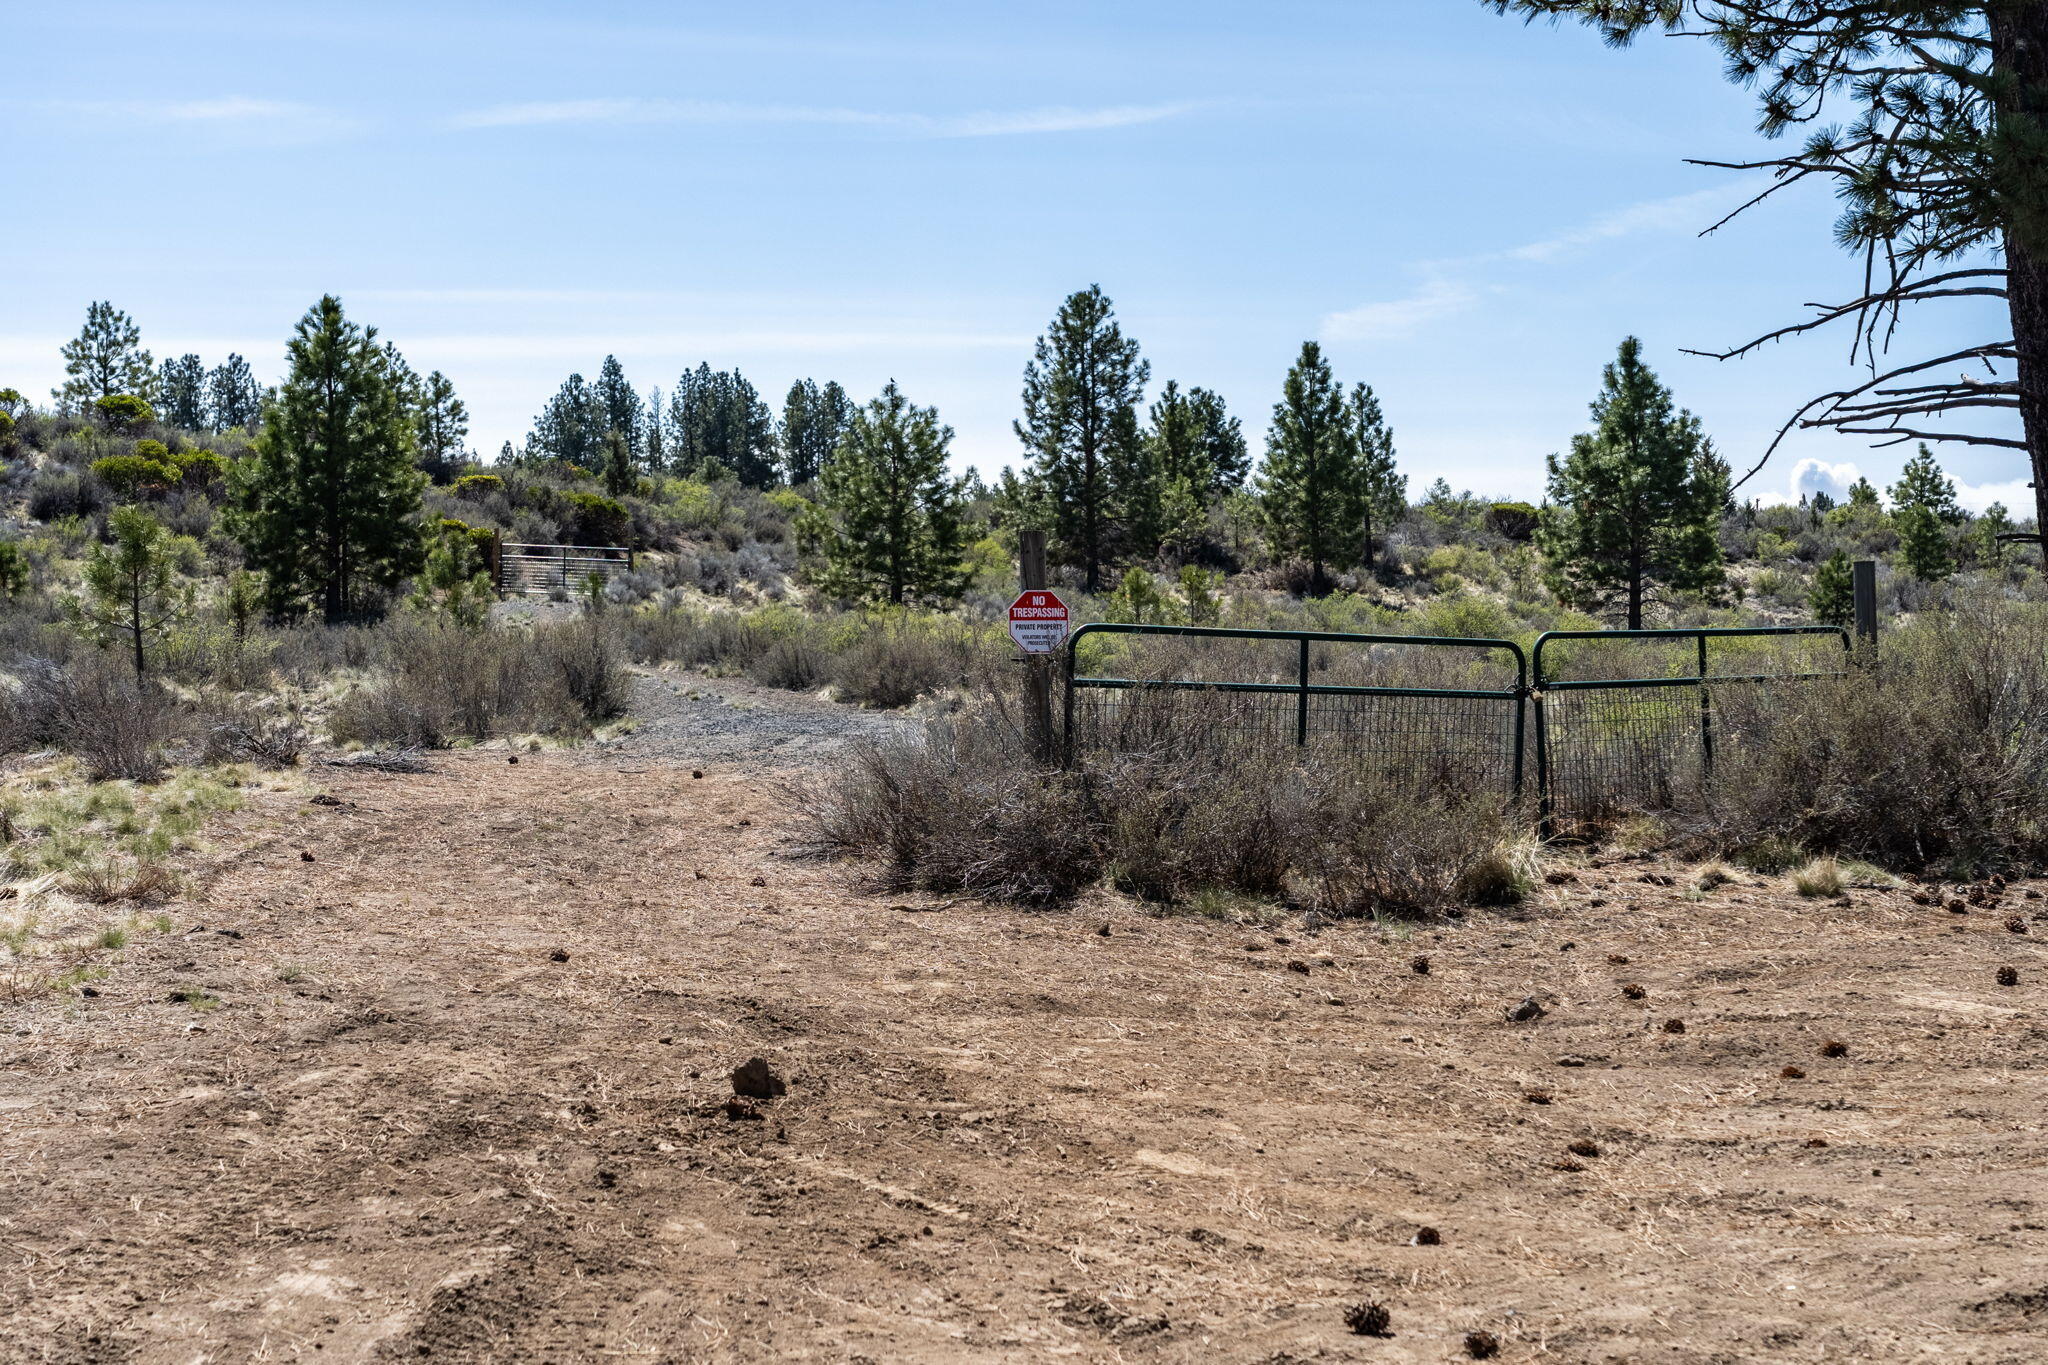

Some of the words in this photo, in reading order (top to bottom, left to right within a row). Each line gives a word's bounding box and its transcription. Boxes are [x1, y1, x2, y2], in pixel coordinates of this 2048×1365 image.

[1032, 595, 1046, 606] NO
[1012, 607, 1066, 618] TRESPASSING
[1015, 623, 1036, 631] PRIVATE
[1036, 623, 1063, 631] PROPERTY
